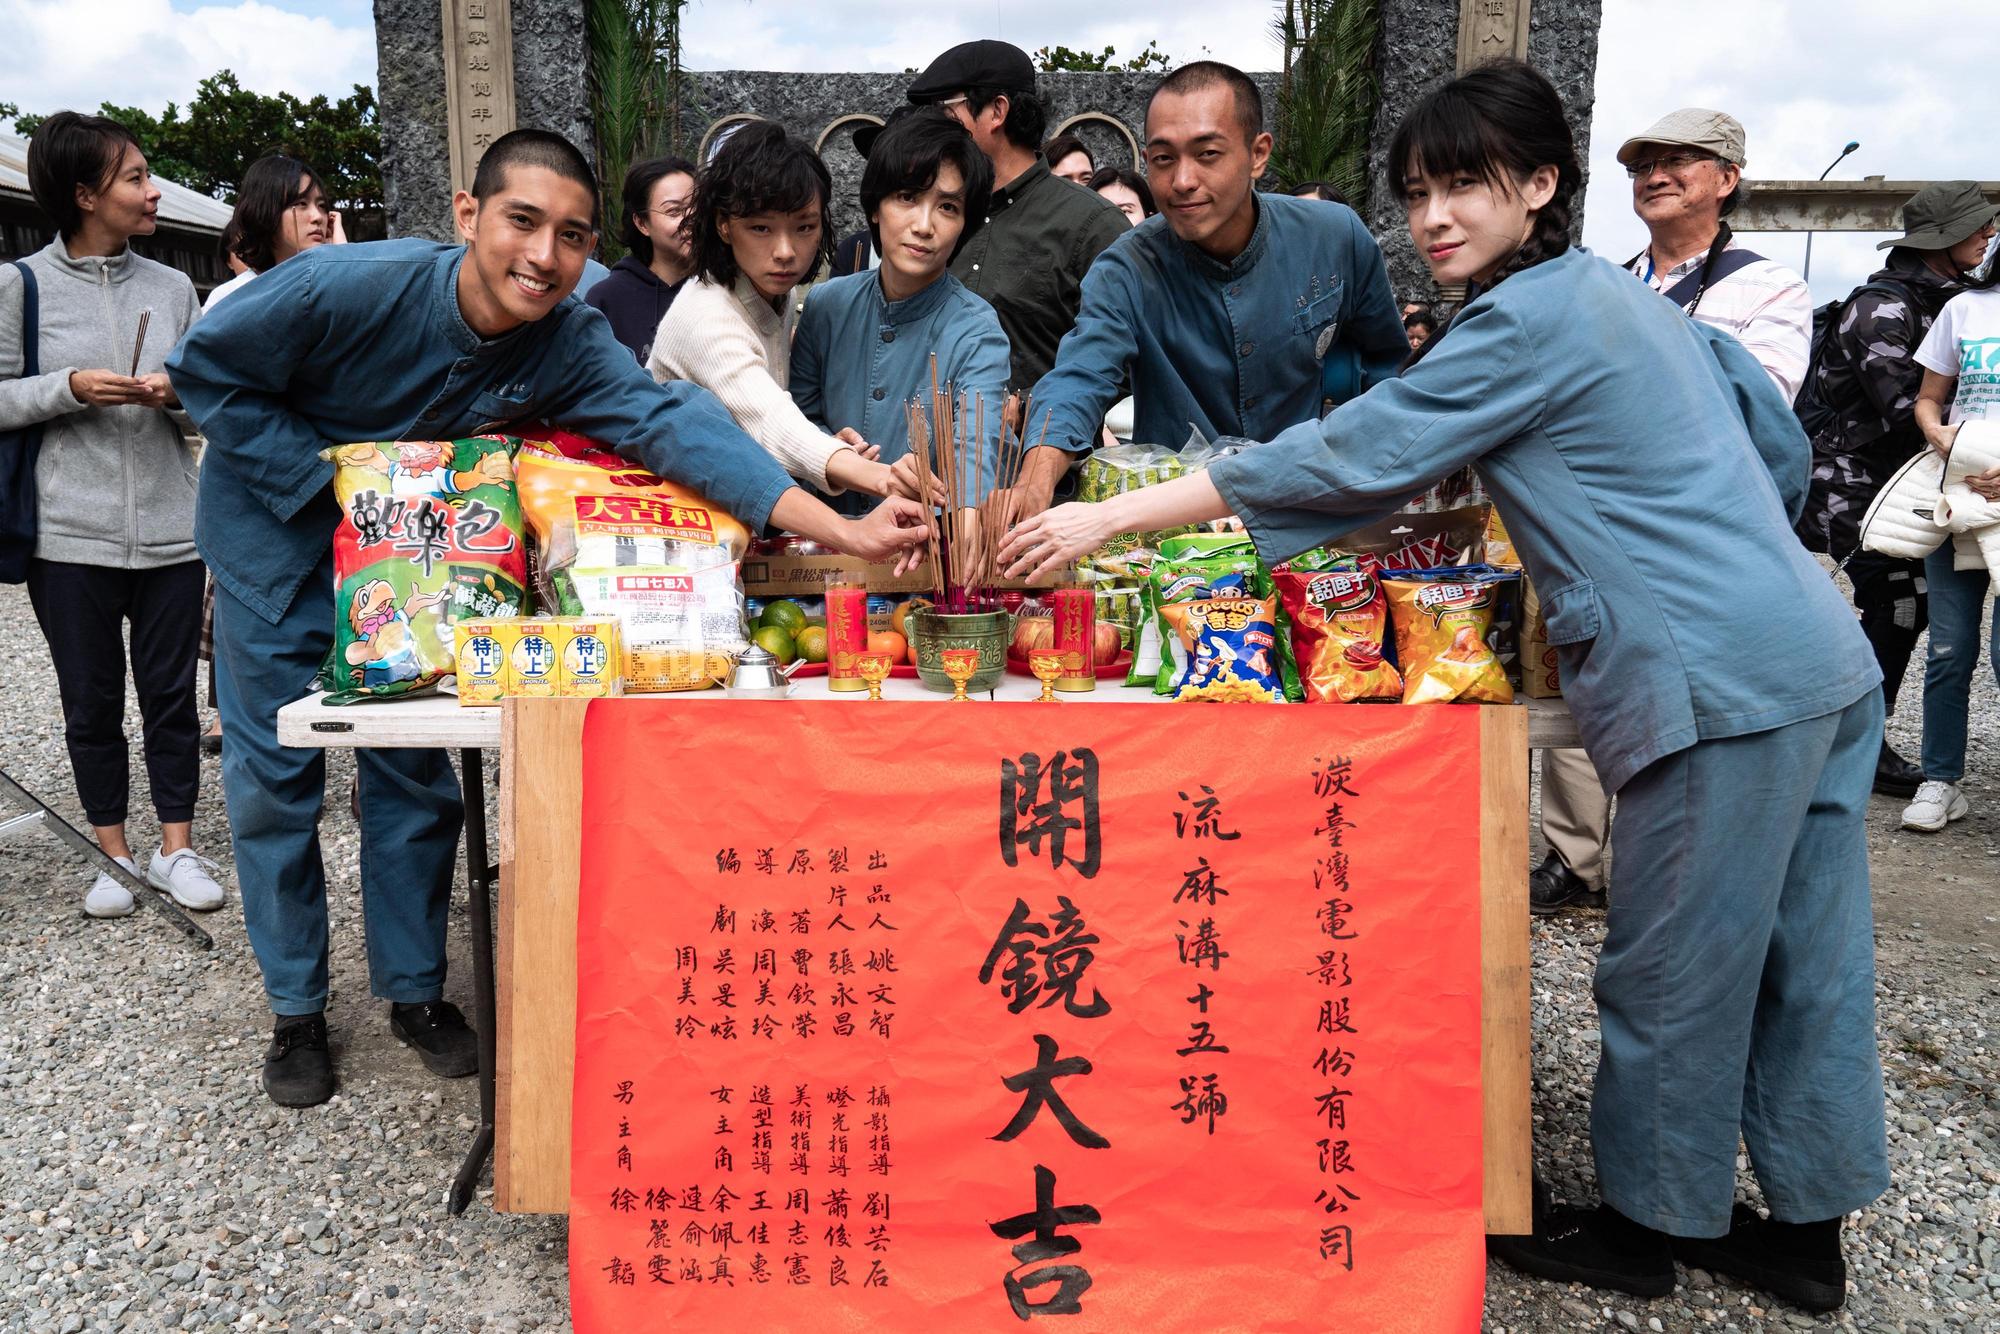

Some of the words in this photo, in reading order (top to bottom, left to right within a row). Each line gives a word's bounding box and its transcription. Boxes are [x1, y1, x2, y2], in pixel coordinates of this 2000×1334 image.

[351, 489, 515, 577] 歡樂包
[579, 497, 707, 527] 大吉利
[1190, 601, 1258, 617] Cheetos
[1311, 571, 1367, 603] 話匣子
[1419, 583, 1484, 608] 話匣子
[1205, 611, 1248, 630] 奇多
[473, 637, 492, 675] 特上
[524, 637, 543, 675] 特上
[576, 636, 595, 674] 特上
[1170, 784, 1242, 1136] 流麻溝十五號
[674, 945, 706, 1040] 周美玲
[751, 948, 783, 1040] 周美玲
[978, 746, 1113, 1322] 開鏡大吉
[613, 1080, 635, 1173] 男主角
[710, 1085, 734, 1173] 女主角
[644, 1186, 677, 1286] 徐麗雯
